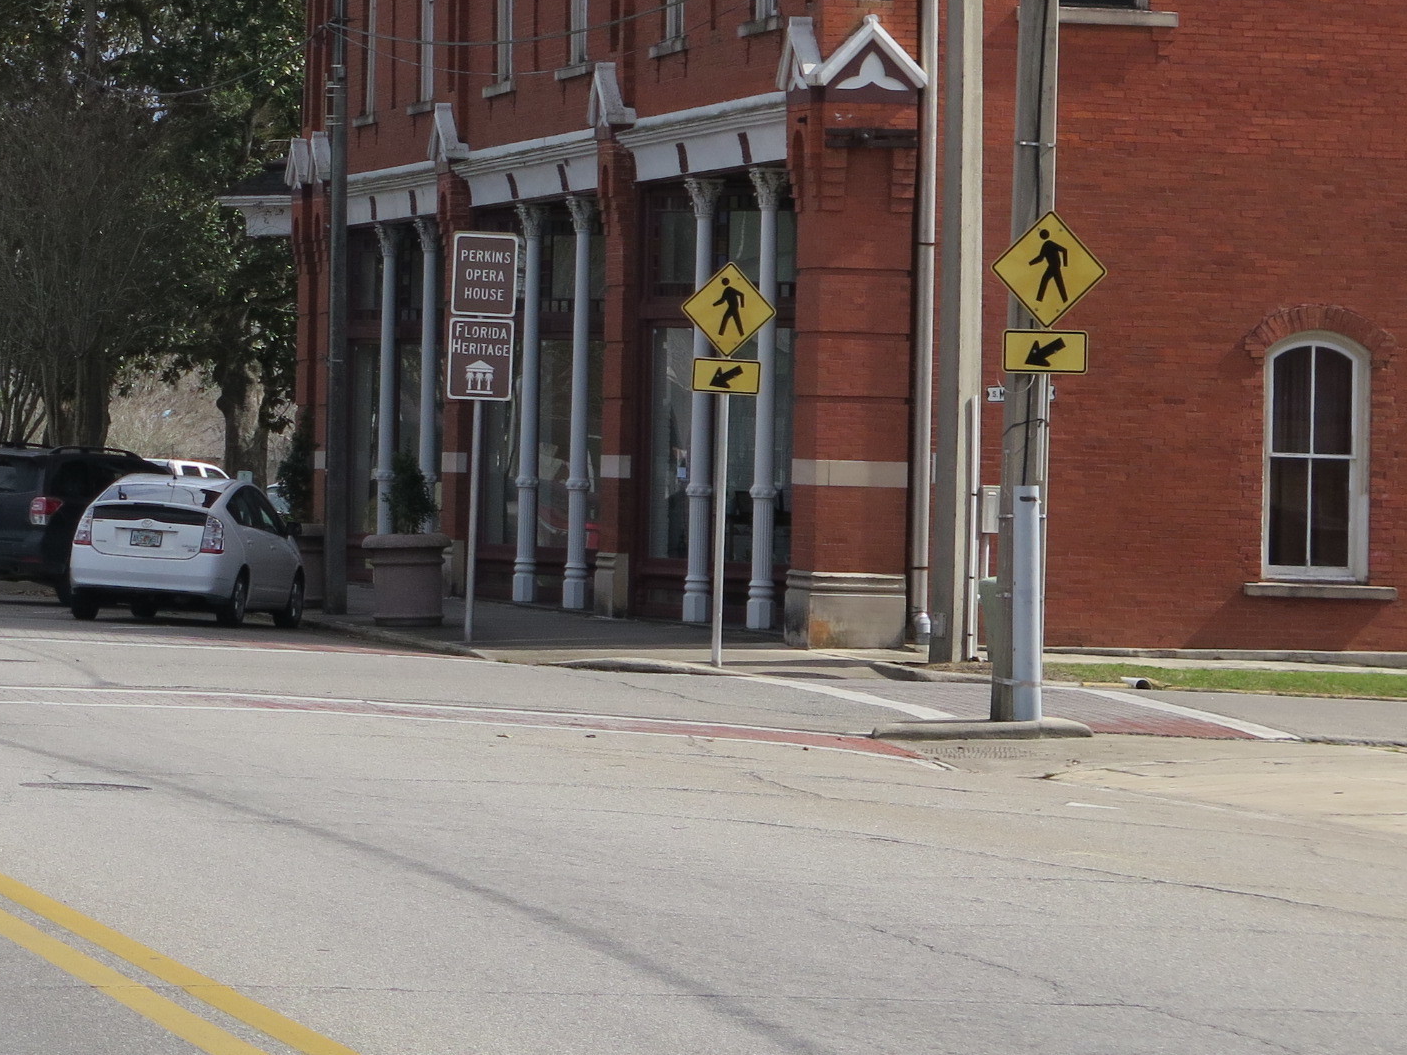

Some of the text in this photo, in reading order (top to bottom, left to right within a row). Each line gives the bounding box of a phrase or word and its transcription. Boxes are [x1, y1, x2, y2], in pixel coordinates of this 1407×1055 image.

[461, 249, 511, 264] PERKINS
[465, 268, 505, 282] OPERA
[464, 287, 505, 301] HOUSE
[455, 322, 508, 340] FLORIDA
[452, 338, 511, 357] HERITAGE
